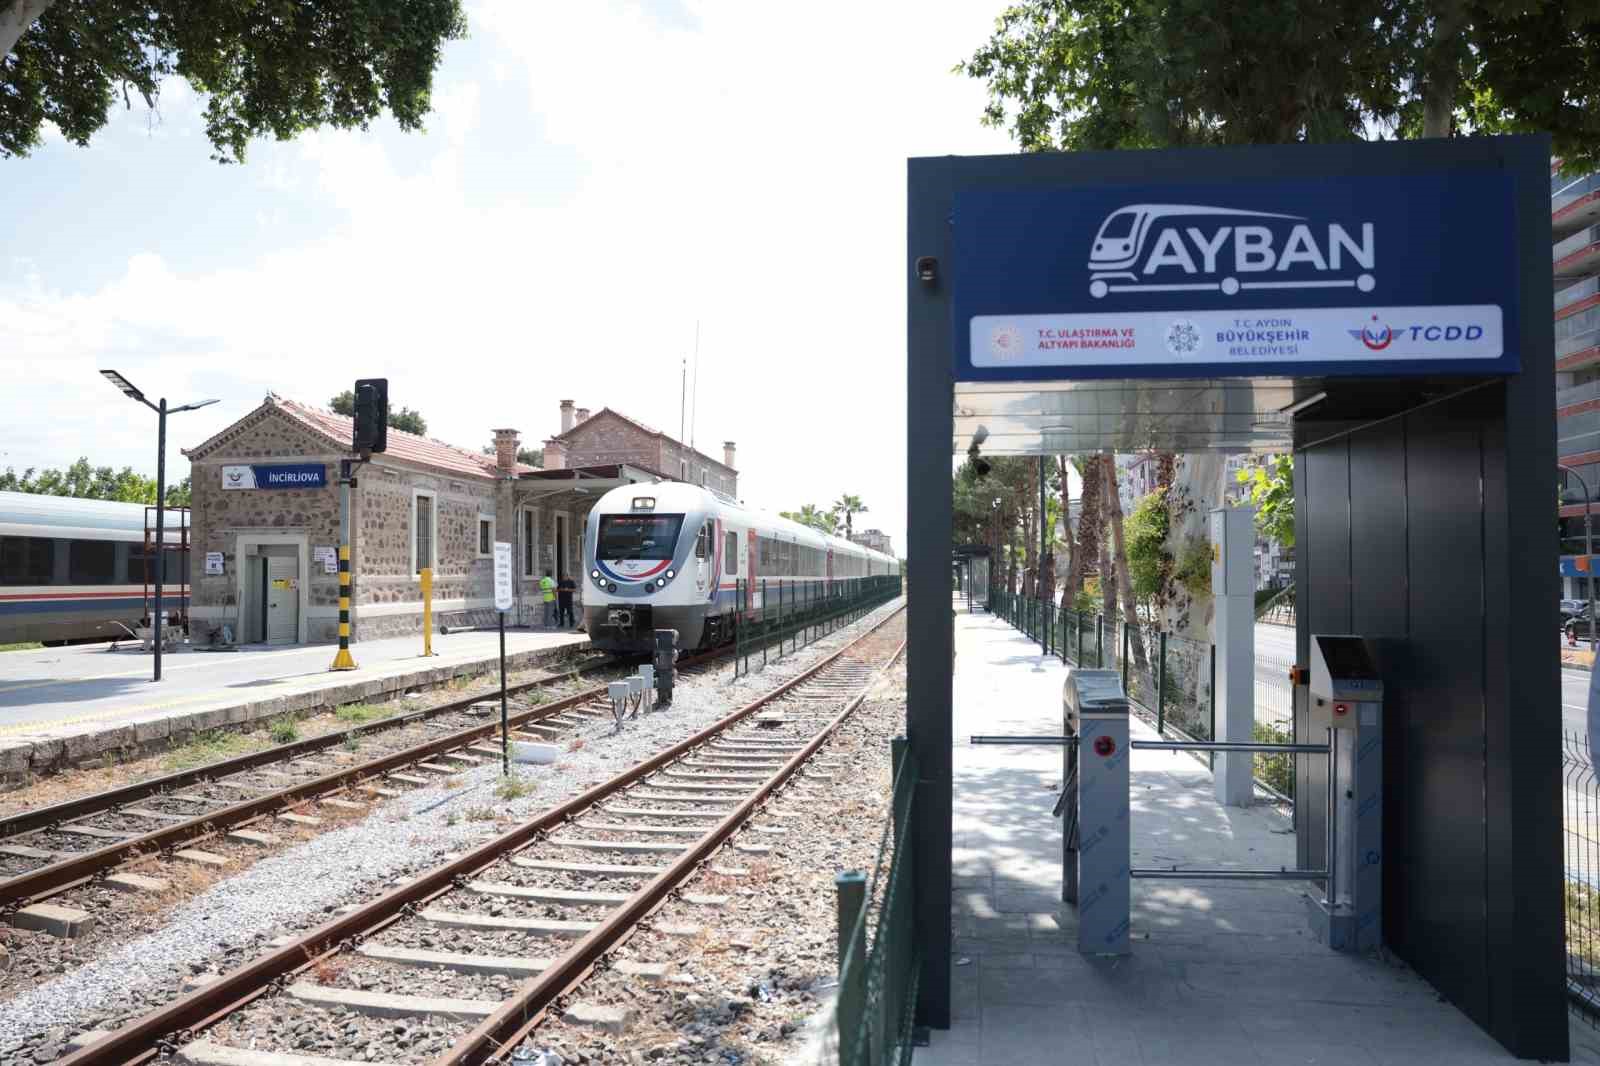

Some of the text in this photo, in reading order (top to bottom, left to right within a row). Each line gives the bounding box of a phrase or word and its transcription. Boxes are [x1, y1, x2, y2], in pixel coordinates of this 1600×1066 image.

[1143, 222, 1375, 275] AYBAN
[1256, 319, 1292, 328] AYDIN
[1038, 328, 1136, 339] T.C. ULAŞTIRMA VE
[1216, 329, 1310, 344] BÜYÜKŞEHİR
[1409, 326, 1483, 341] TCDD
[1038, 338, 1136, 350] ALTYAPI BAKANLIĞI
[1229, 344, 1299, 356] BELEDİYESİ
